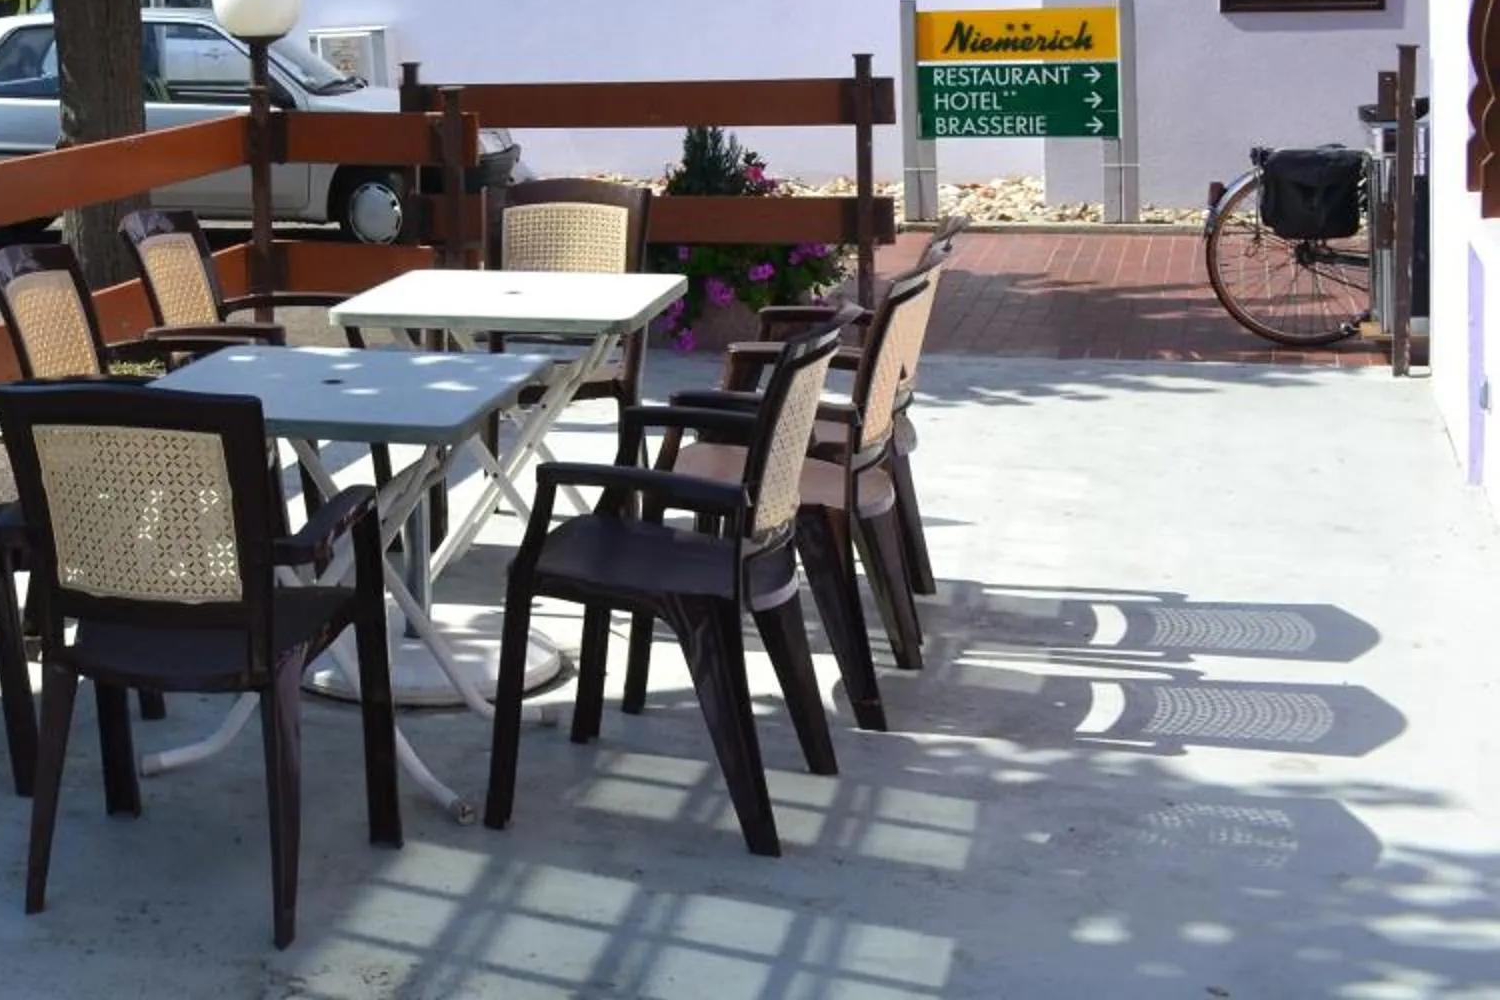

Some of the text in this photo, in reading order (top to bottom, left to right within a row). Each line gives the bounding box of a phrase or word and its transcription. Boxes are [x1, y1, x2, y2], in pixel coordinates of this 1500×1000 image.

[942, 19, 1094, 54] Niemerich
[933, 66, 1071, 87] RESTAURANT
[934, 91, 1002, 111] HOTEL
[935, 115, 1048, 135] BRASSERIE
